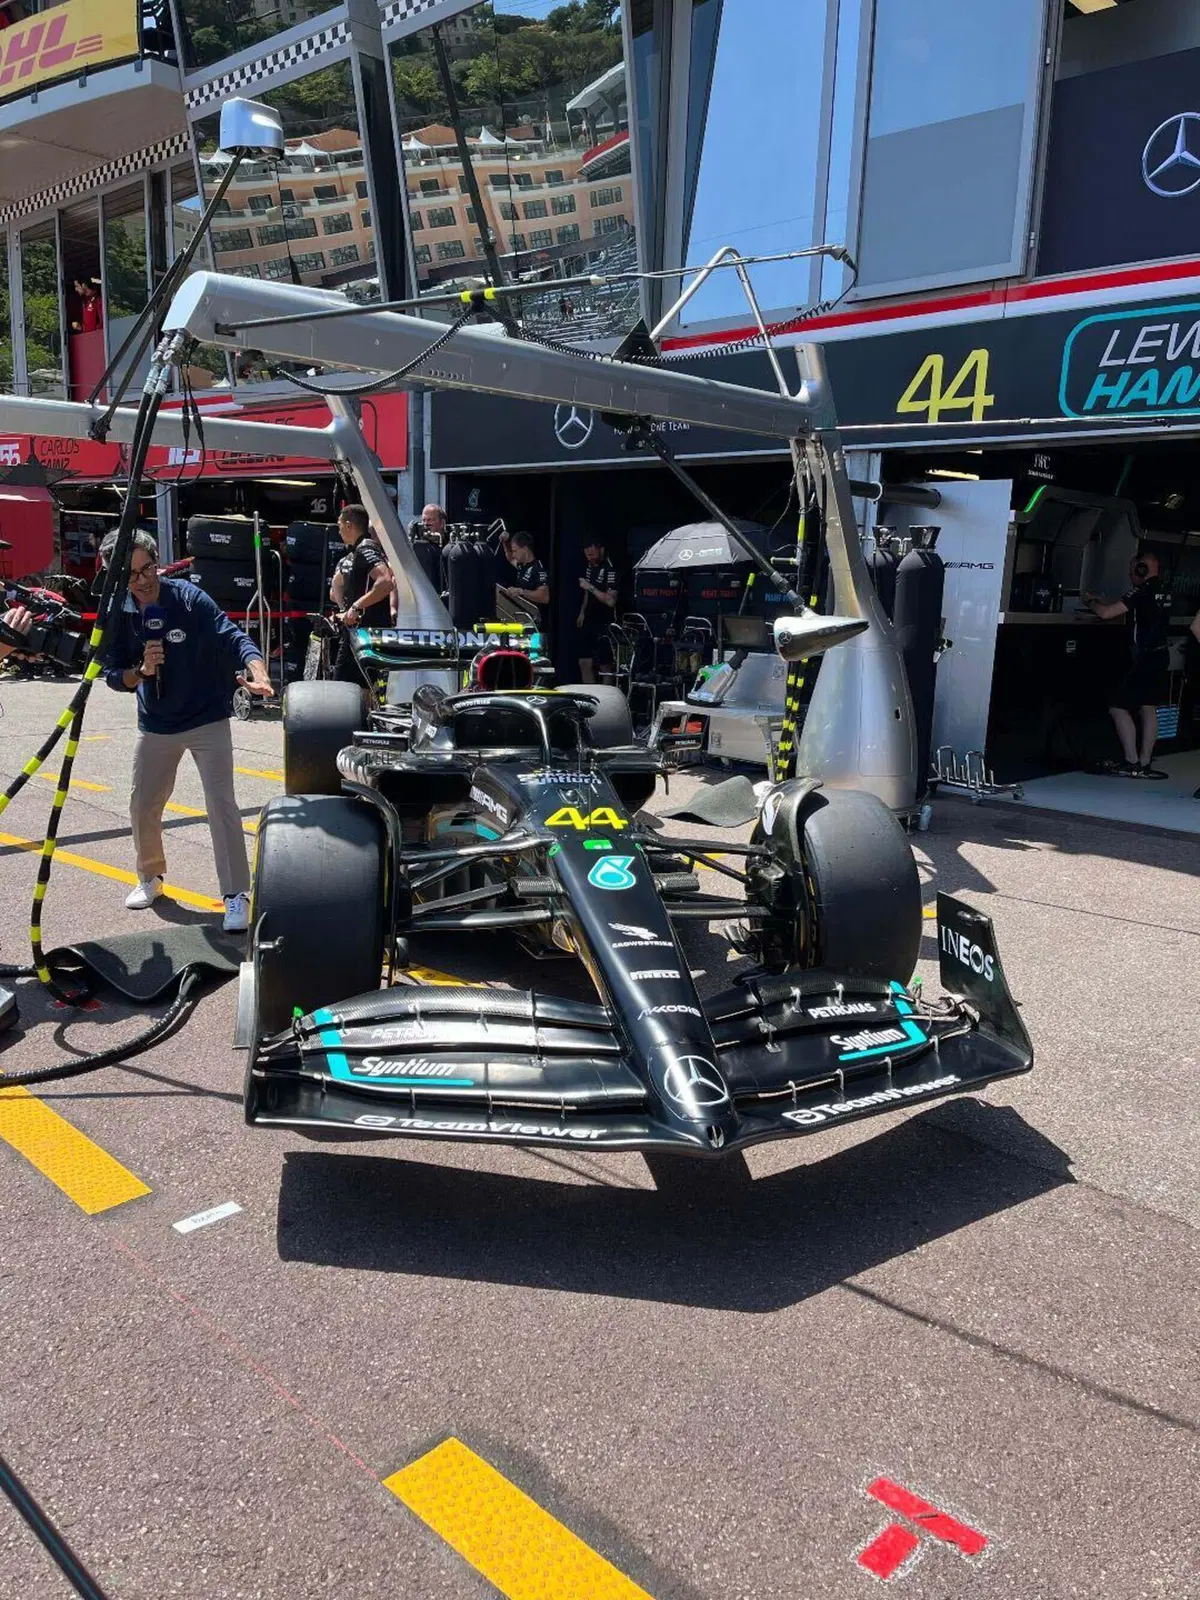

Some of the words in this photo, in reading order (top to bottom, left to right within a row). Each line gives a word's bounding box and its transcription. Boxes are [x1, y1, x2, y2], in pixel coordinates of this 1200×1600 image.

[0, 13, 77, 86] HL
[896, 348, 995, 424] 44
[40, 440, 80, 456] CARLOS
[956, 562, 994, 570] AMG
[478, 791, 508, 825] AMG
[543, 806, 629, 831] 44
[940, 924, 995, 982] INEOS
[808, 1002, 877, 1019] PETRONAS
[830, 1028, 907, 1051] Syntium
[353, 1056, 456, 1077] Syntium
[811, 1074, 962, 1116] TeamViewer
[397, 1118, 608, 1140] TeamViewer
